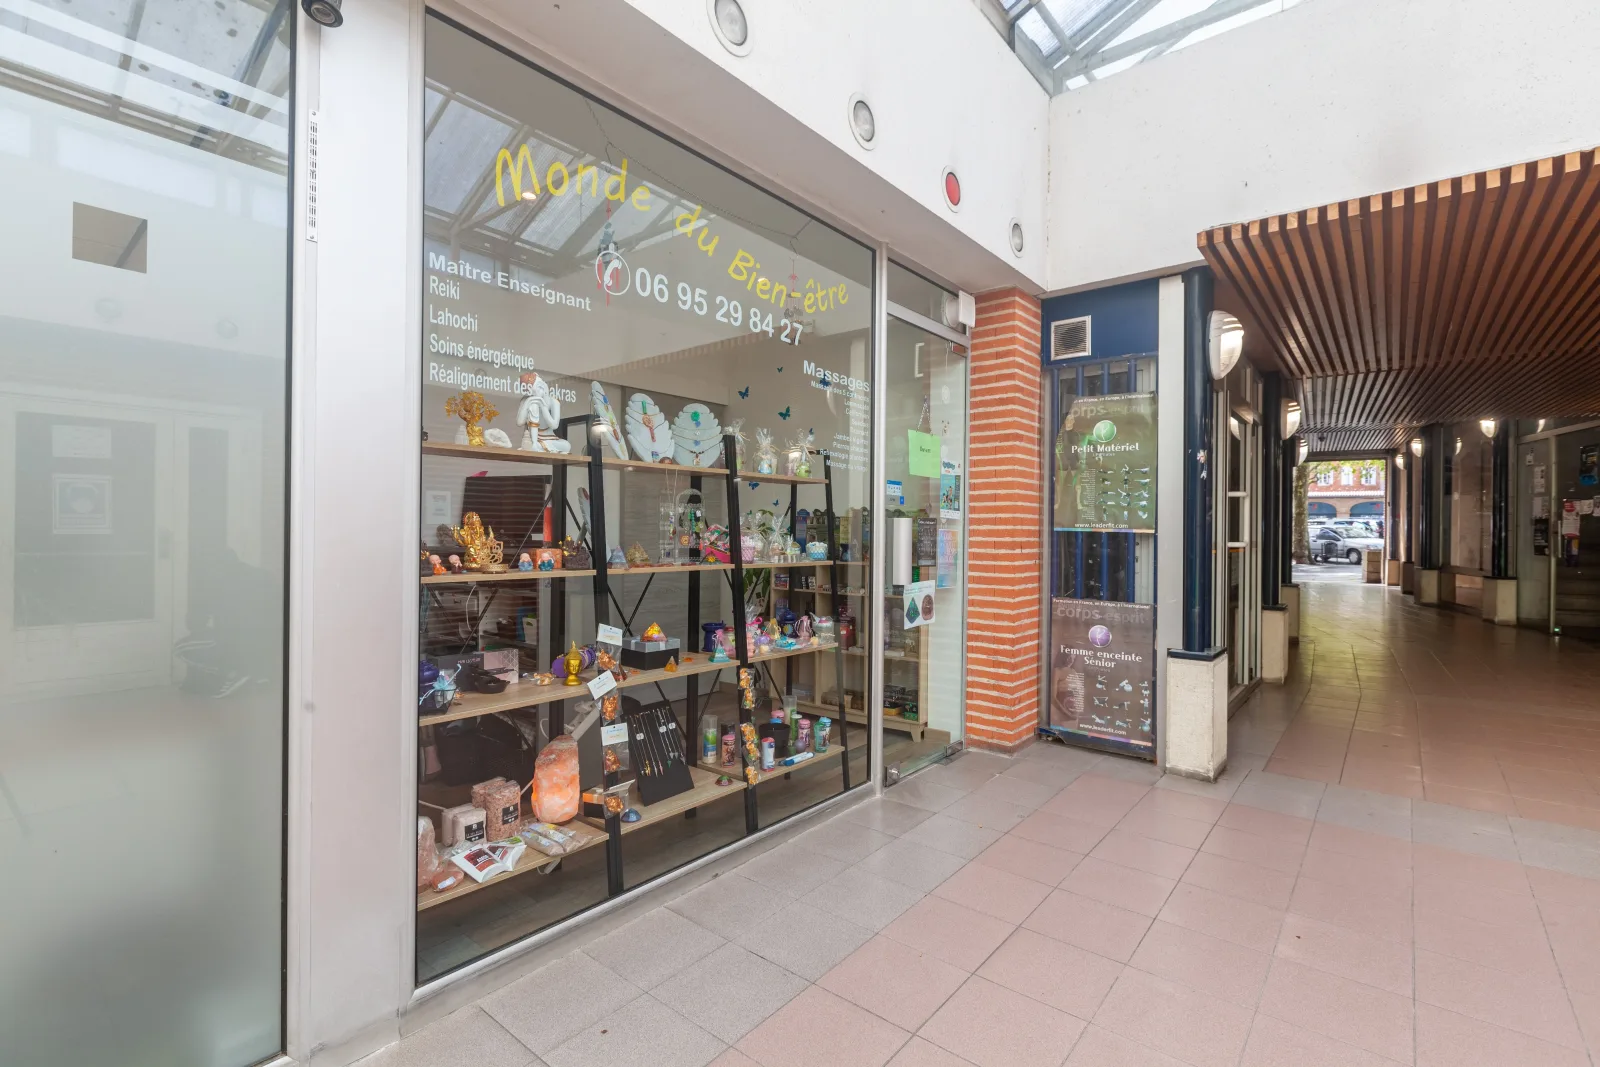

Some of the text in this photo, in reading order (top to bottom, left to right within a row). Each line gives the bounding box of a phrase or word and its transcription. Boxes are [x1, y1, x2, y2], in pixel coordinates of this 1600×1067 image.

[495, 143, 849, 313] Monde du Bien-être
[429, 252, 591, 311] Maître Enseignant
[429, 275, 460, 300] Reiki
[429, 304, 478, 332] Lahochi
[635, 267, 803, 346] 06 95 29 84 27
[429, 333, 534, 372] Soins énérgétique
[429, 362, 577, 403] Réalignement des akras
[803, 360, 870, 392] Massages
[1071, 442, 1140, 454] Petit Matériel
[1060, 644, 1143, 663] Femme enceinte
[1084, 656, 1117, 668] Sénior
[1079, 723, 1127, 735] www.leaderfit.com
